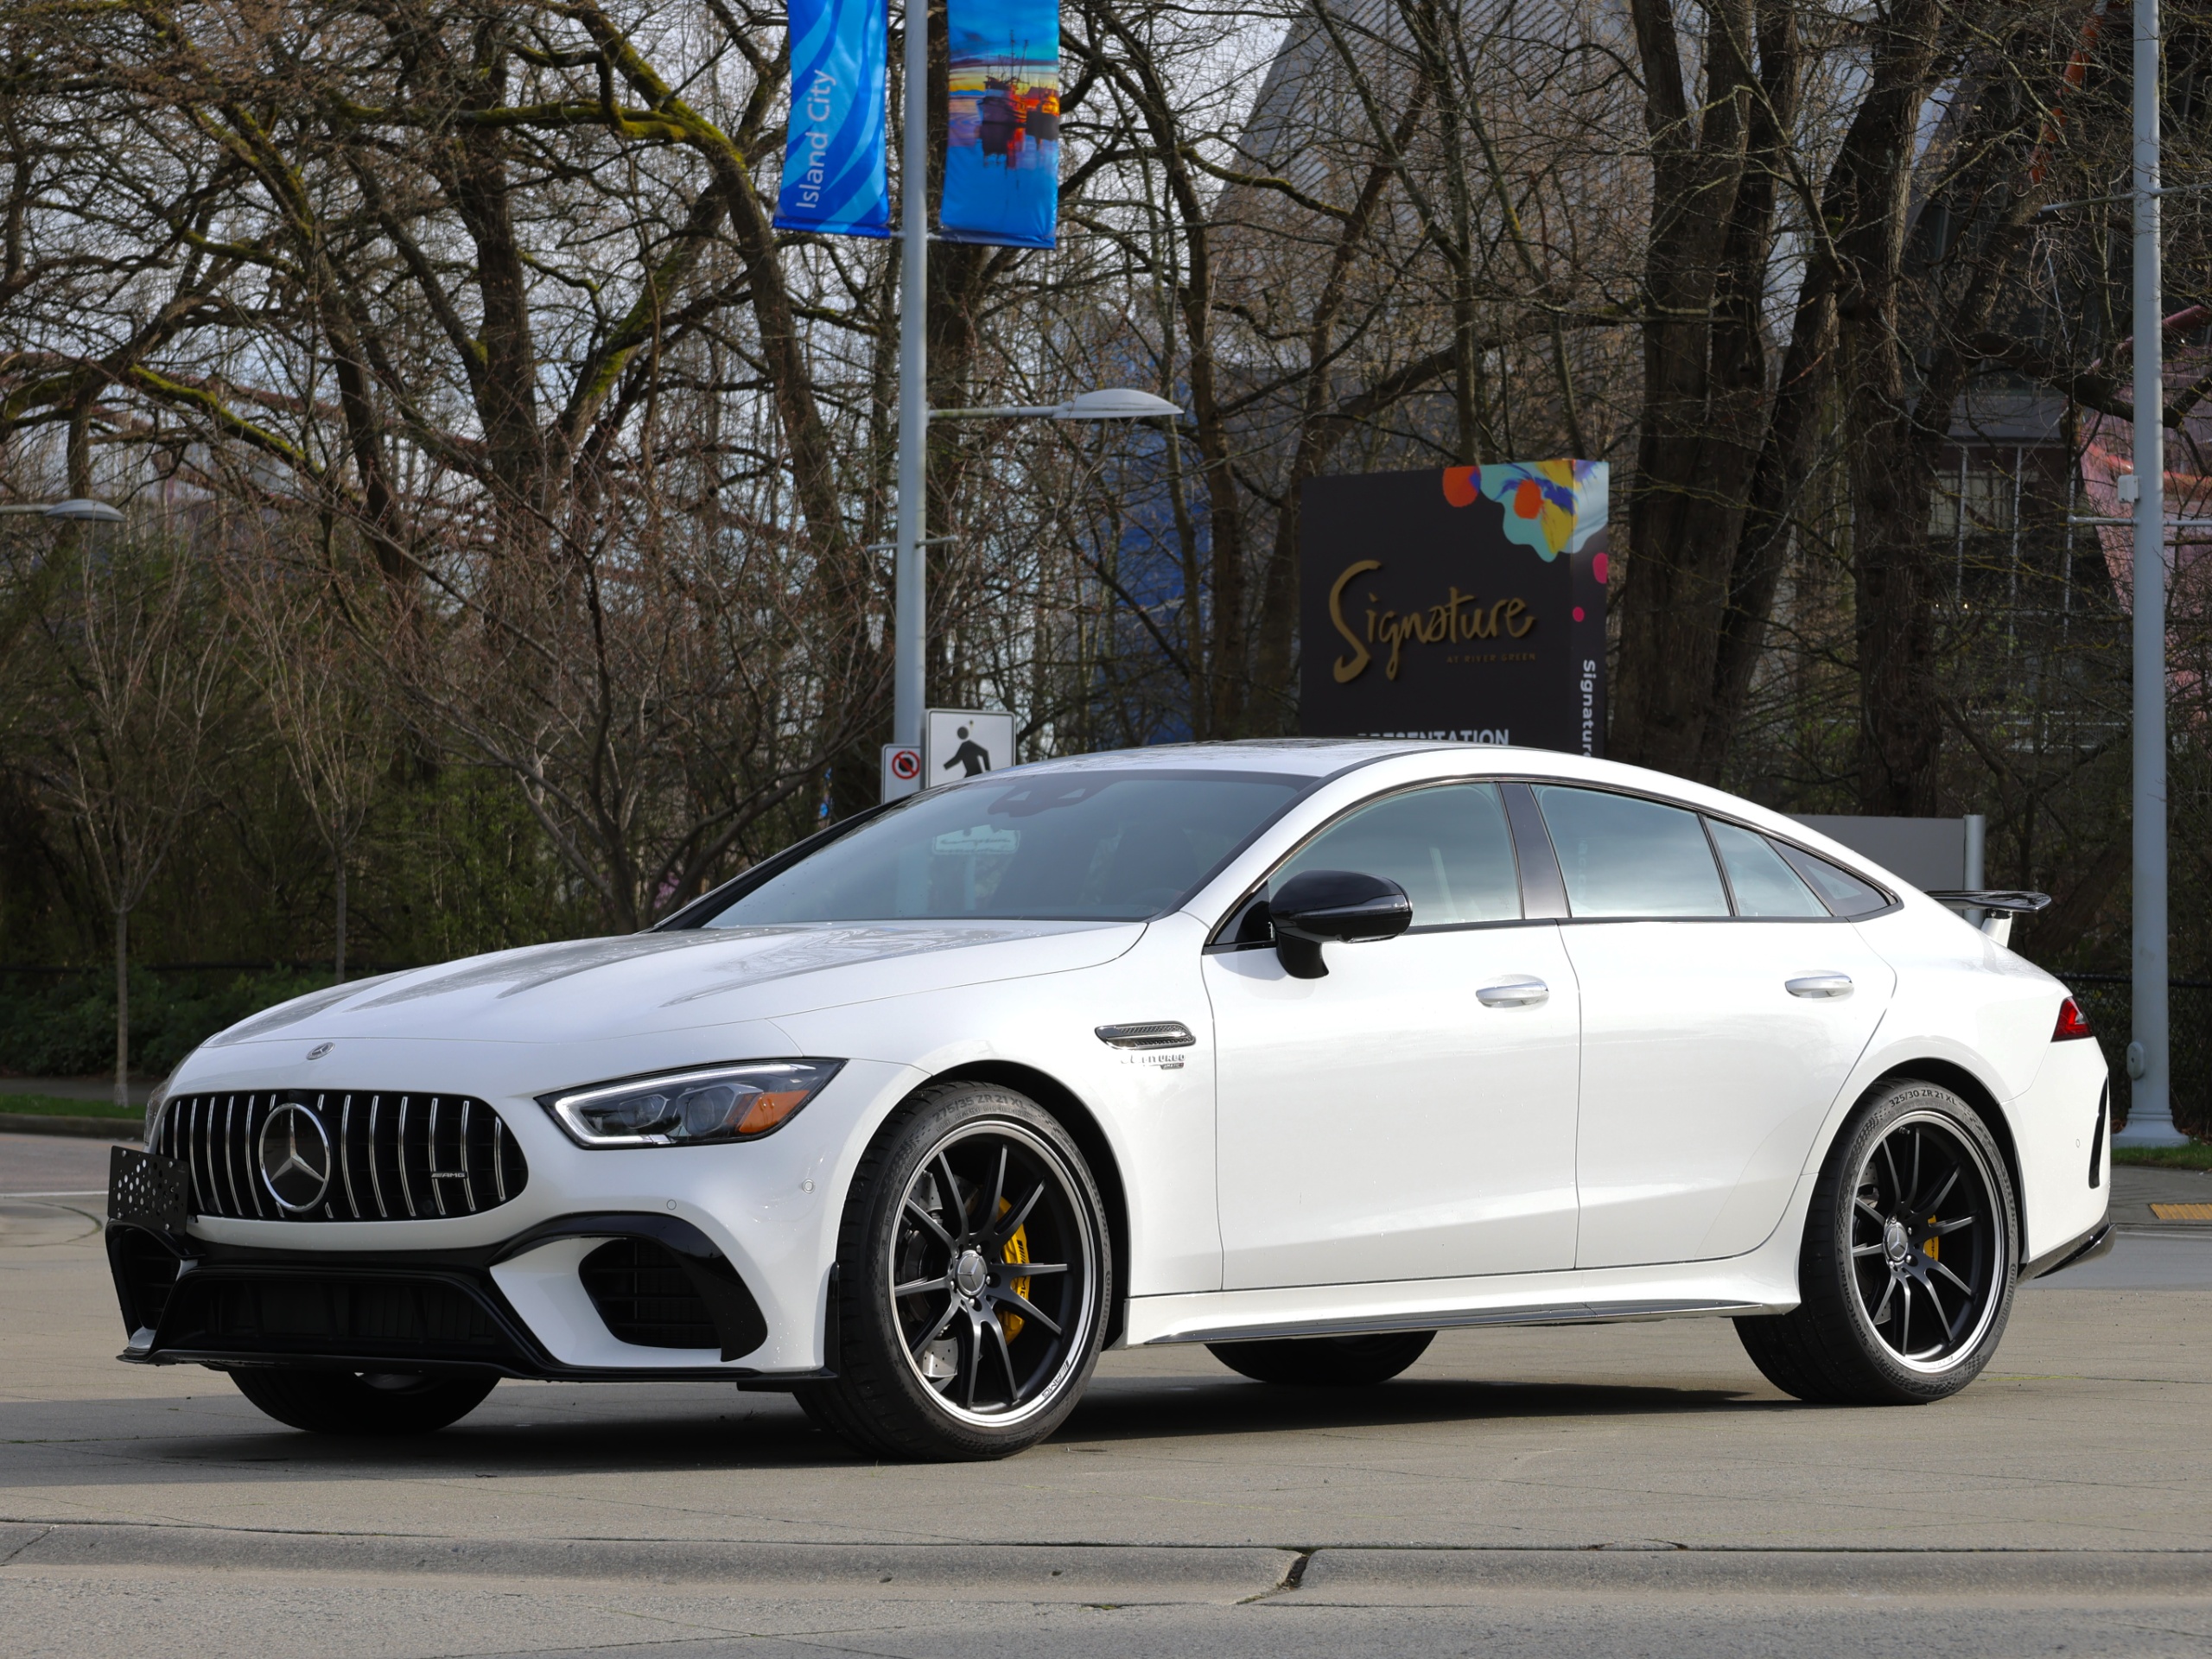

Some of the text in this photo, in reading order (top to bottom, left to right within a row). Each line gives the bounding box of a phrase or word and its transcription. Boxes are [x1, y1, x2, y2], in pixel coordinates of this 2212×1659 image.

[796, 69, 836, 208] Island City
[1329, 560, 1536, 683] Signature
[1446, 652, 1536, 664] AT RIVER GREEN
[932, 1096, 974, 1122] 275/35
[976, 1094, 993, 1104] ZR
[995, 1094, 1008, 1104] 21
[1011, 1096, 1027, 1109] XL
[1889, 1089, 1956, 1108] 325/30 ZR 21 XL
[1839, 1261, 1868, 1346] SportContact
